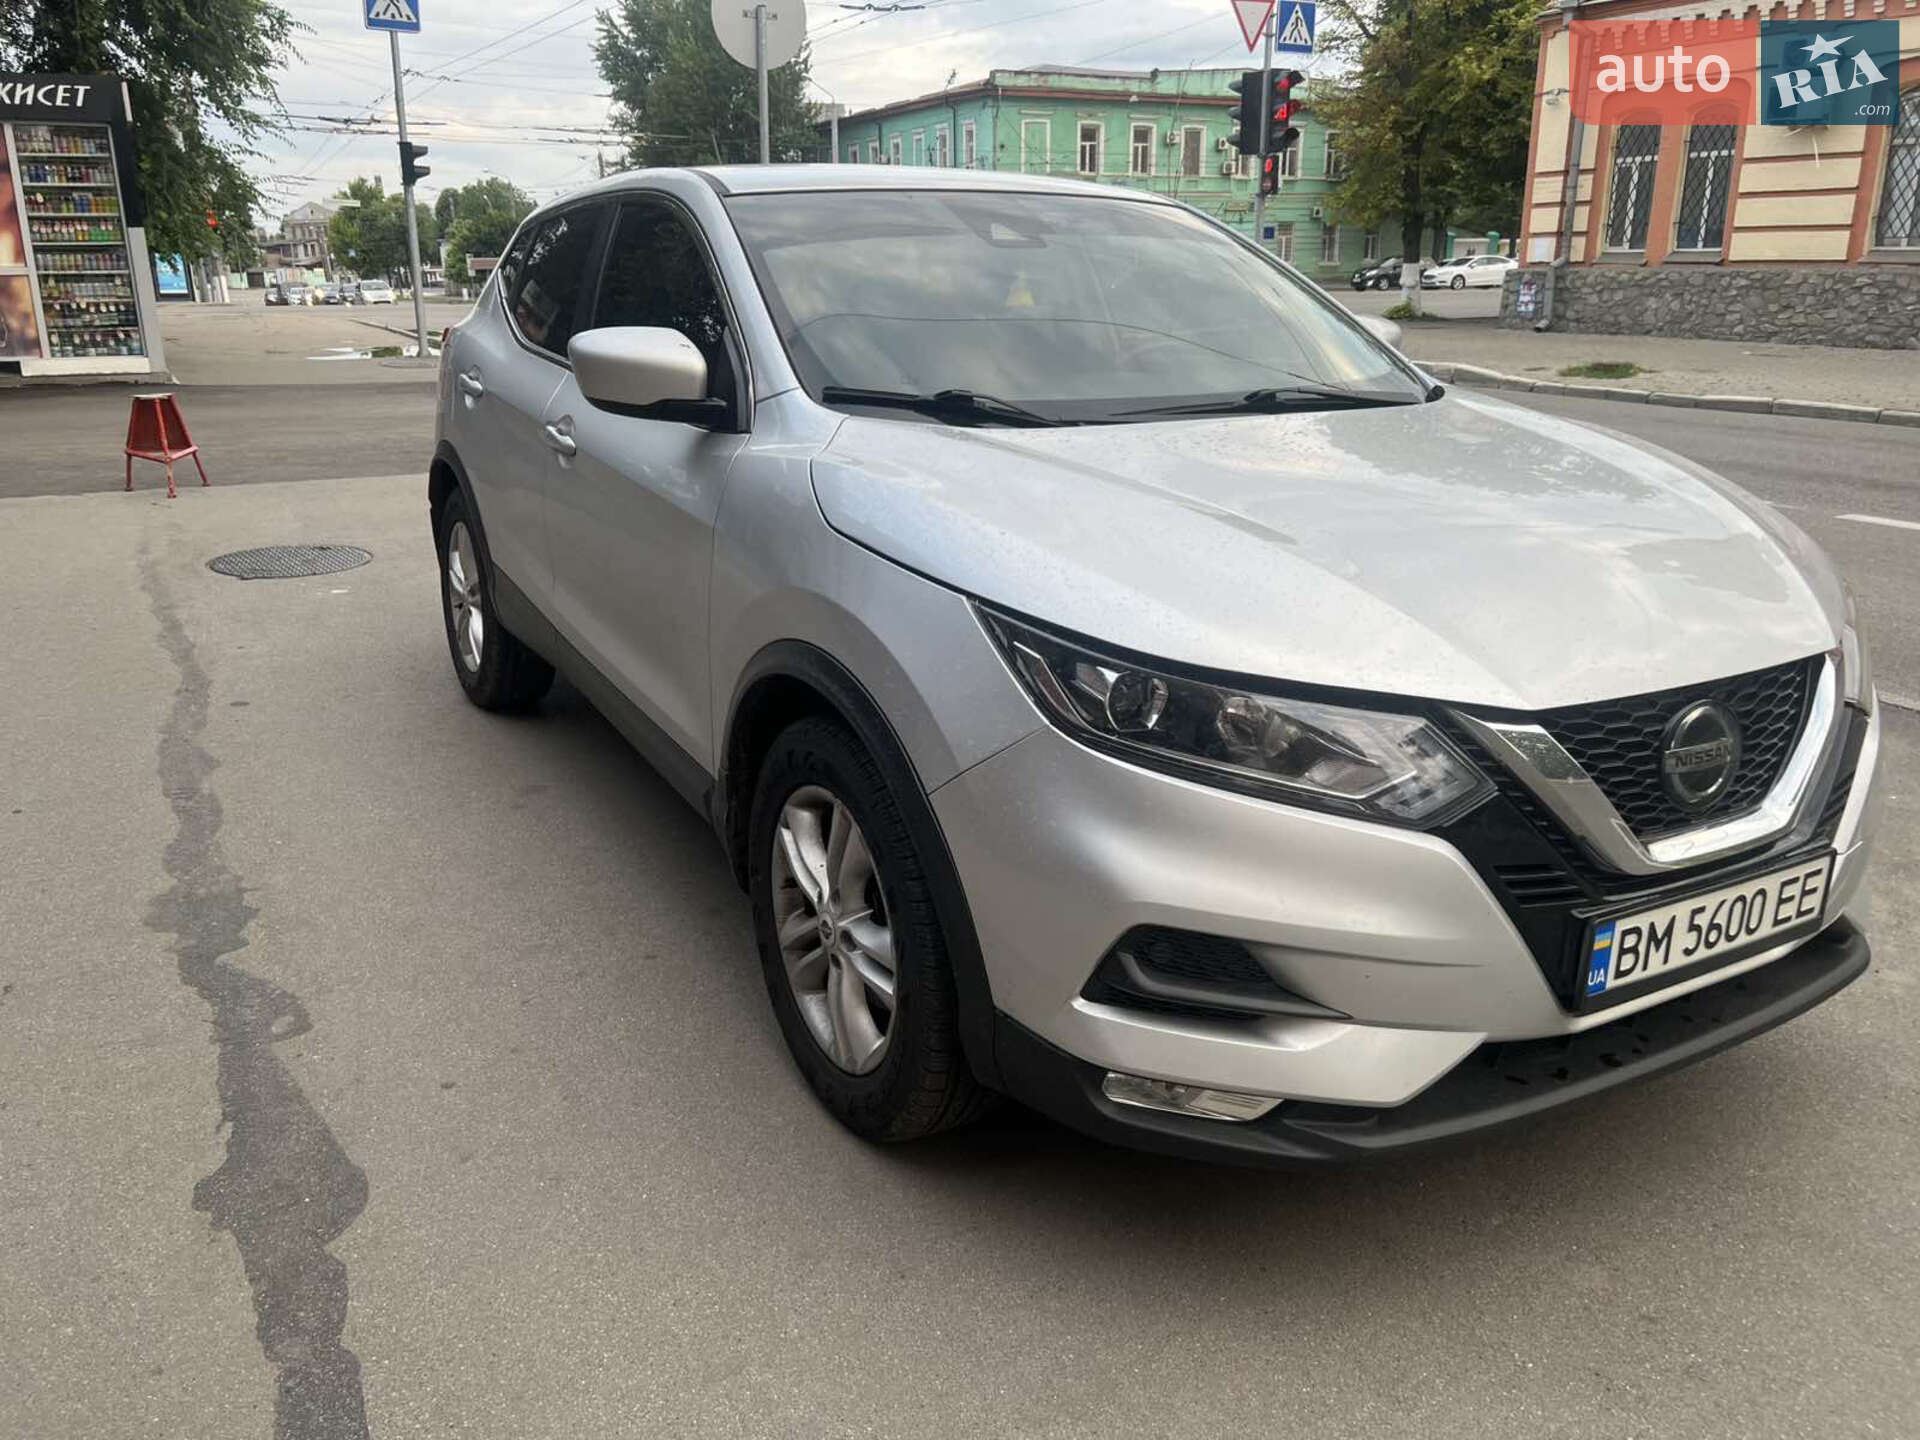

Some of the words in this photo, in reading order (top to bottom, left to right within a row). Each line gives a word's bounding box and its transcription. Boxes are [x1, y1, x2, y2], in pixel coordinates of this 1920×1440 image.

[0, 82, 91, 107] КИСЕТ
[1613, 915, 1677, 980] BM
[1683, 888, 1767, 957] 5600
[1772, 868, 1823, 928] EE
[1588, 969, 1606, 986] UA
